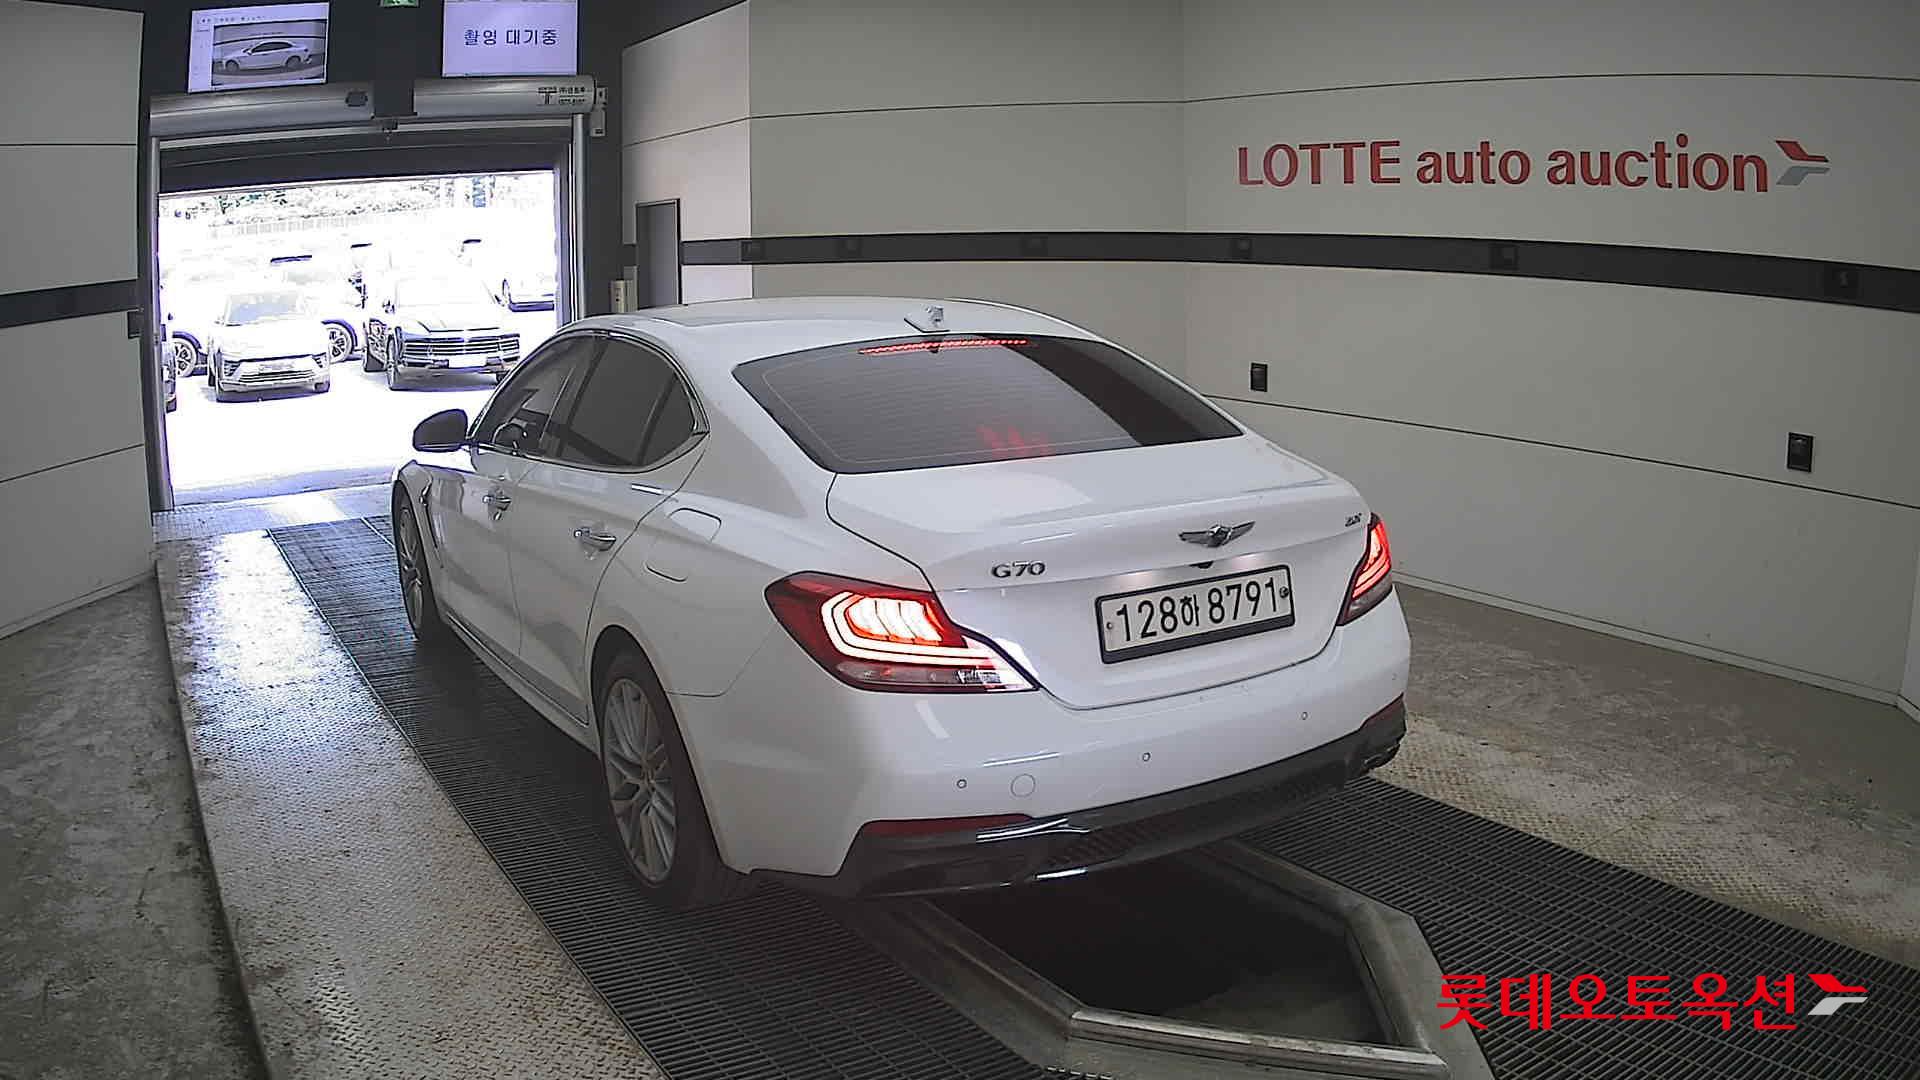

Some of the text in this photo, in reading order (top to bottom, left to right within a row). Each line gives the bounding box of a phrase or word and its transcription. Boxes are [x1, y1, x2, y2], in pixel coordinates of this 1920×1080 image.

[506, 29, 557, 46] 대기중
[1238, 133, 1769, 193] LOTTE auto auction
[991, 561, 1046, 578] G70
[1115, 576, 1277, 642] 128하 8791
